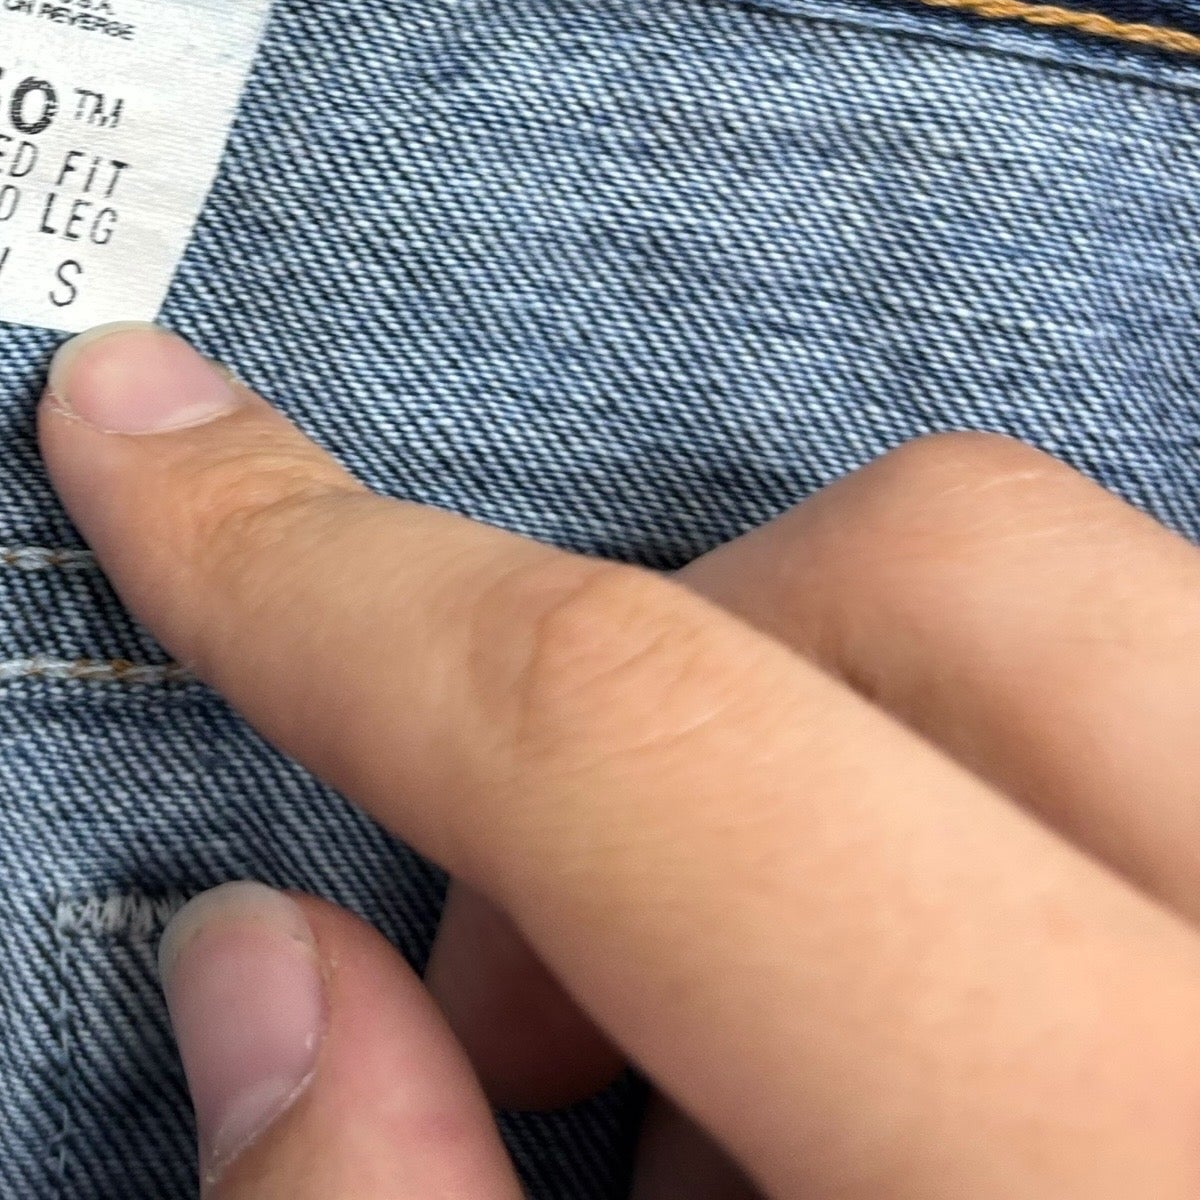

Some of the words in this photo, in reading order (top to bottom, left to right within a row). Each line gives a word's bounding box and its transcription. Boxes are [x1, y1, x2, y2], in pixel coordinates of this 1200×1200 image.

[38, 2, 136, 41] REVERSE
[56, 150, 130, 199] FIT
[39, 193, 118, 245] LEG
[49, 259, 83, 307] S
